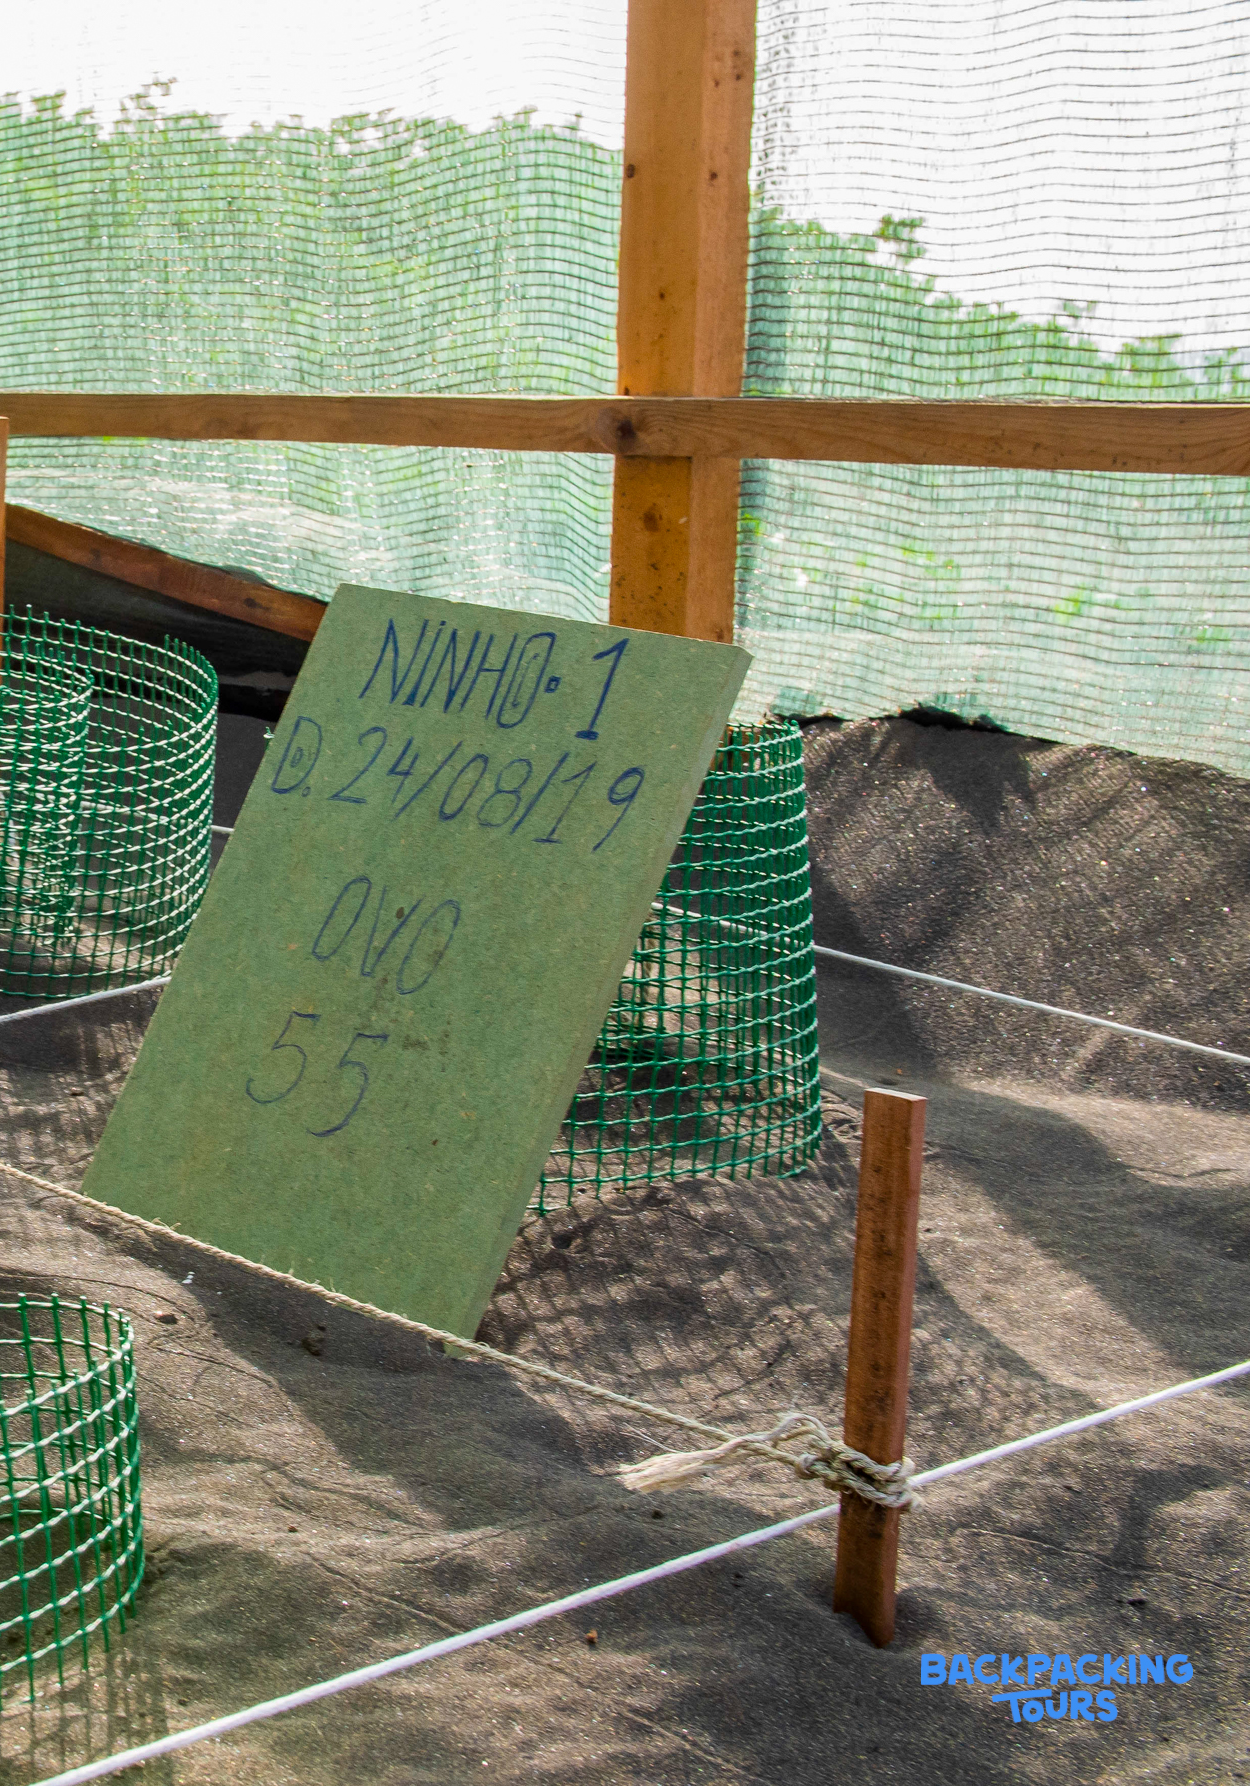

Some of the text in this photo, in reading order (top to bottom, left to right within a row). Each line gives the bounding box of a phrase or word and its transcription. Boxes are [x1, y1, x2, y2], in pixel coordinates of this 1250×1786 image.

[576, 637, 630, 740] 1
[331, 725, 645, 852] 24/08/19
[311, 875, 462, 996] OVO
